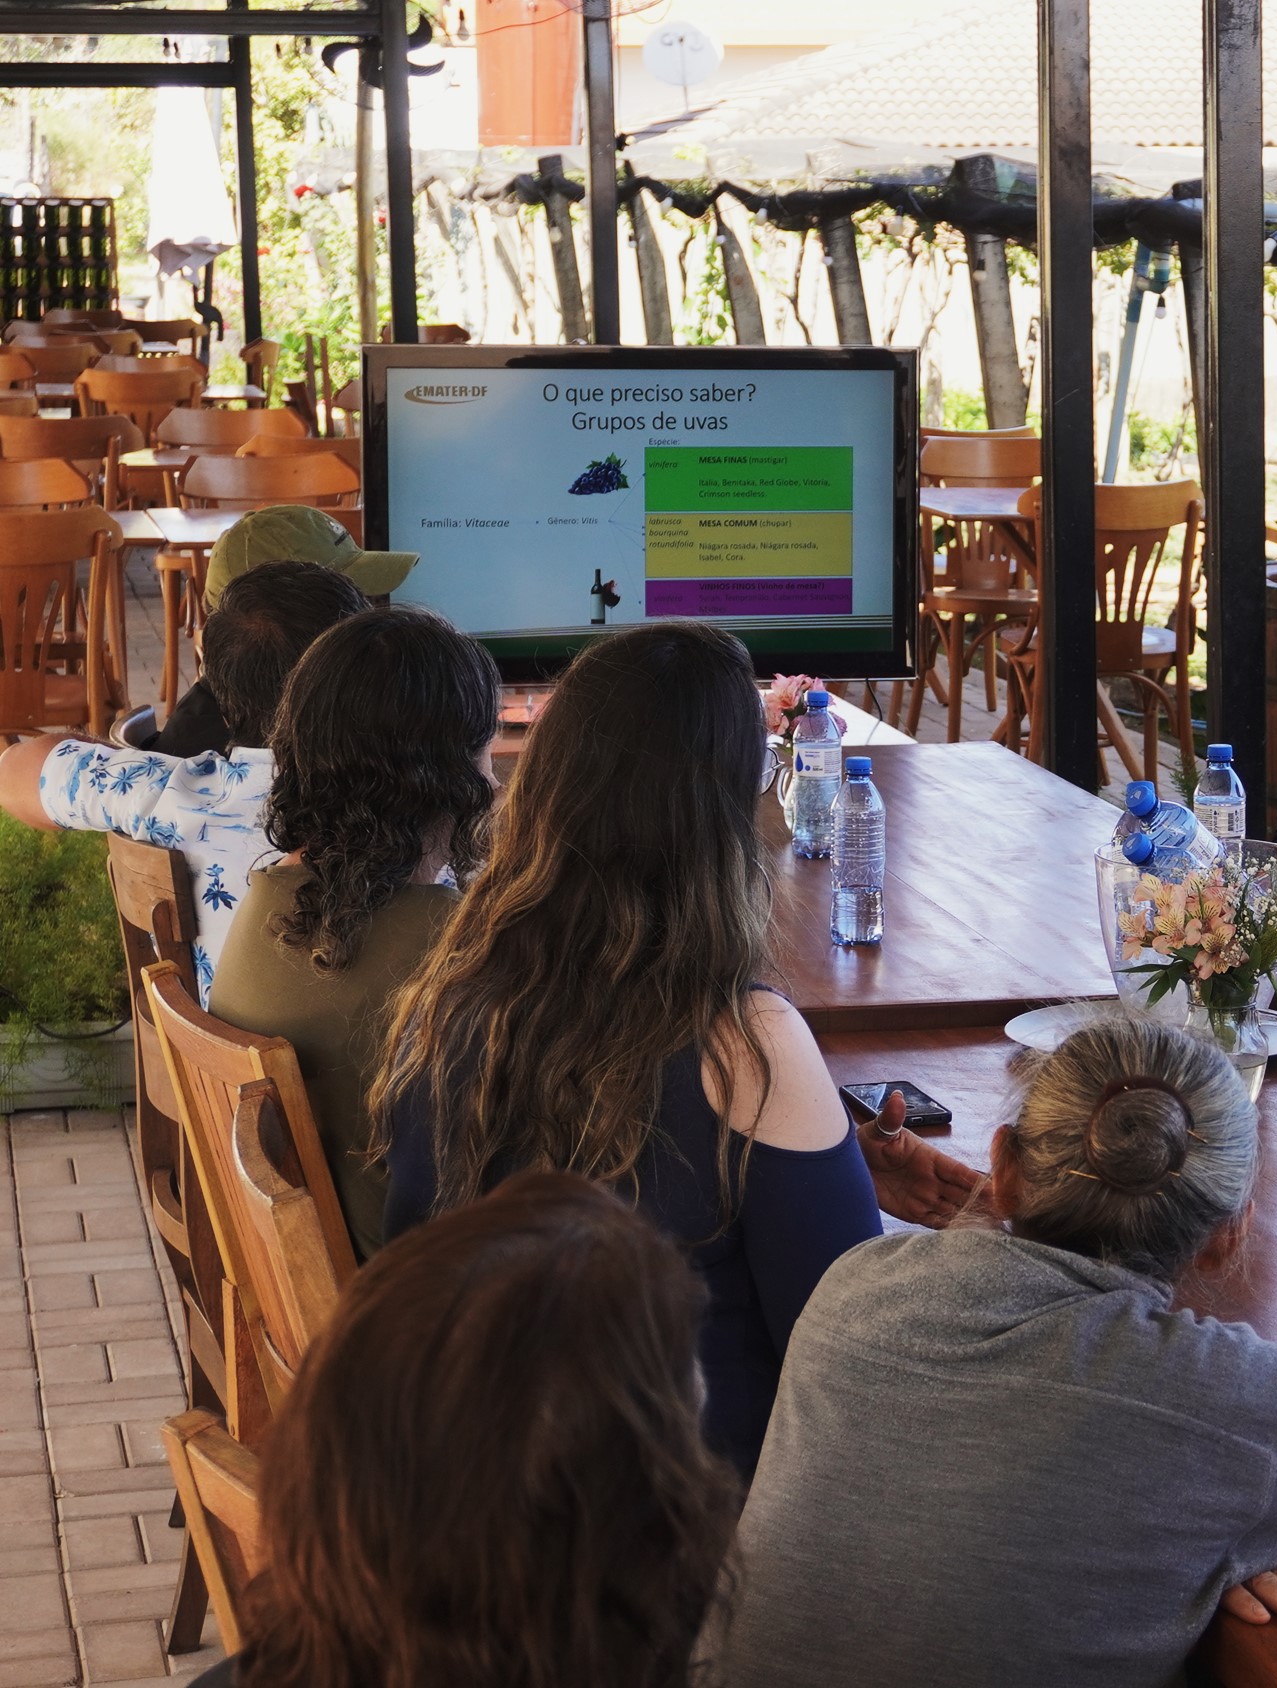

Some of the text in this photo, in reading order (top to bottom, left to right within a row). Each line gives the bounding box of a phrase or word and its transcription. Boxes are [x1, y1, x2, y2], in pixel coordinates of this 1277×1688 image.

[543, 383, 756, 408] O que preciso saber?
[572, 411, 728, 434] Grupos de uvas
[649, 459, 678, 470] vinifera
[699, 455, 788, 466] MESA FINAS (mastigar)
[759, 478, 774, 487] Red
[776, 478, 801, 488] Globe,
[699, 490, 731, 499] Crimson
[421, 518, 510, 528] Família: Vitaceae
[581, 517, 598, 525] Vitis
[649, 517, 682, 526] labrusca
[699, 519, 792, 529] MESA COMUM (chupar)
[649, 539, 694, 550] rotundifolia
[699, 541, 818, 552] Niágara rosada, Niágara rosada,
[699, 553, 746, 563] Isabel, Cora.
[699, 583, 730, 591] VINHOS
[732, 582, 756, 591] FINOS
[785, 582, 795, 590] de
[797, 582, 825, 592] mesa?)
